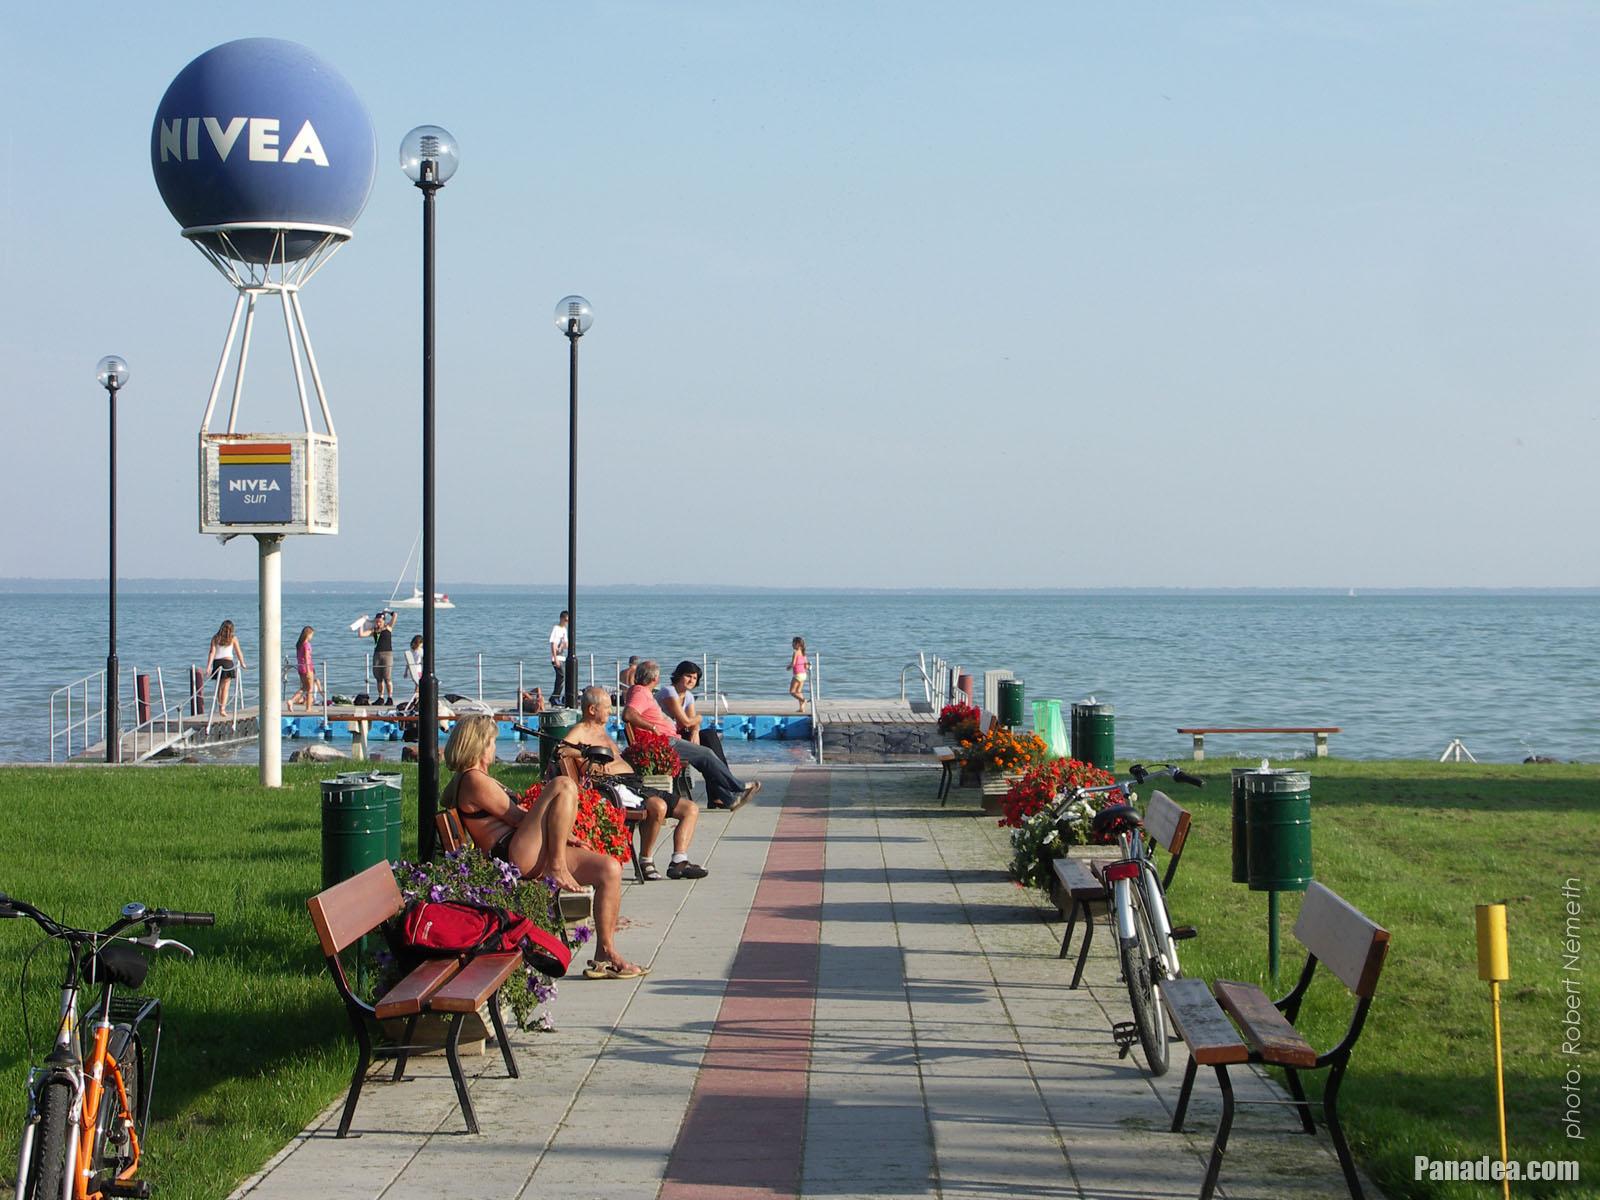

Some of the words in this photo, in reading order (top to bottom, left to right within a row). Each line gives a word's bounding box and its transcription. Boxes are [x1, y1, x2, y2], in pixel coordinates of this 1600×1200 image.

[160, 117, 330, 167] NIVEA
[229, 479, 280, 491] NIVEA
[243, 494, 267, 504] sun
